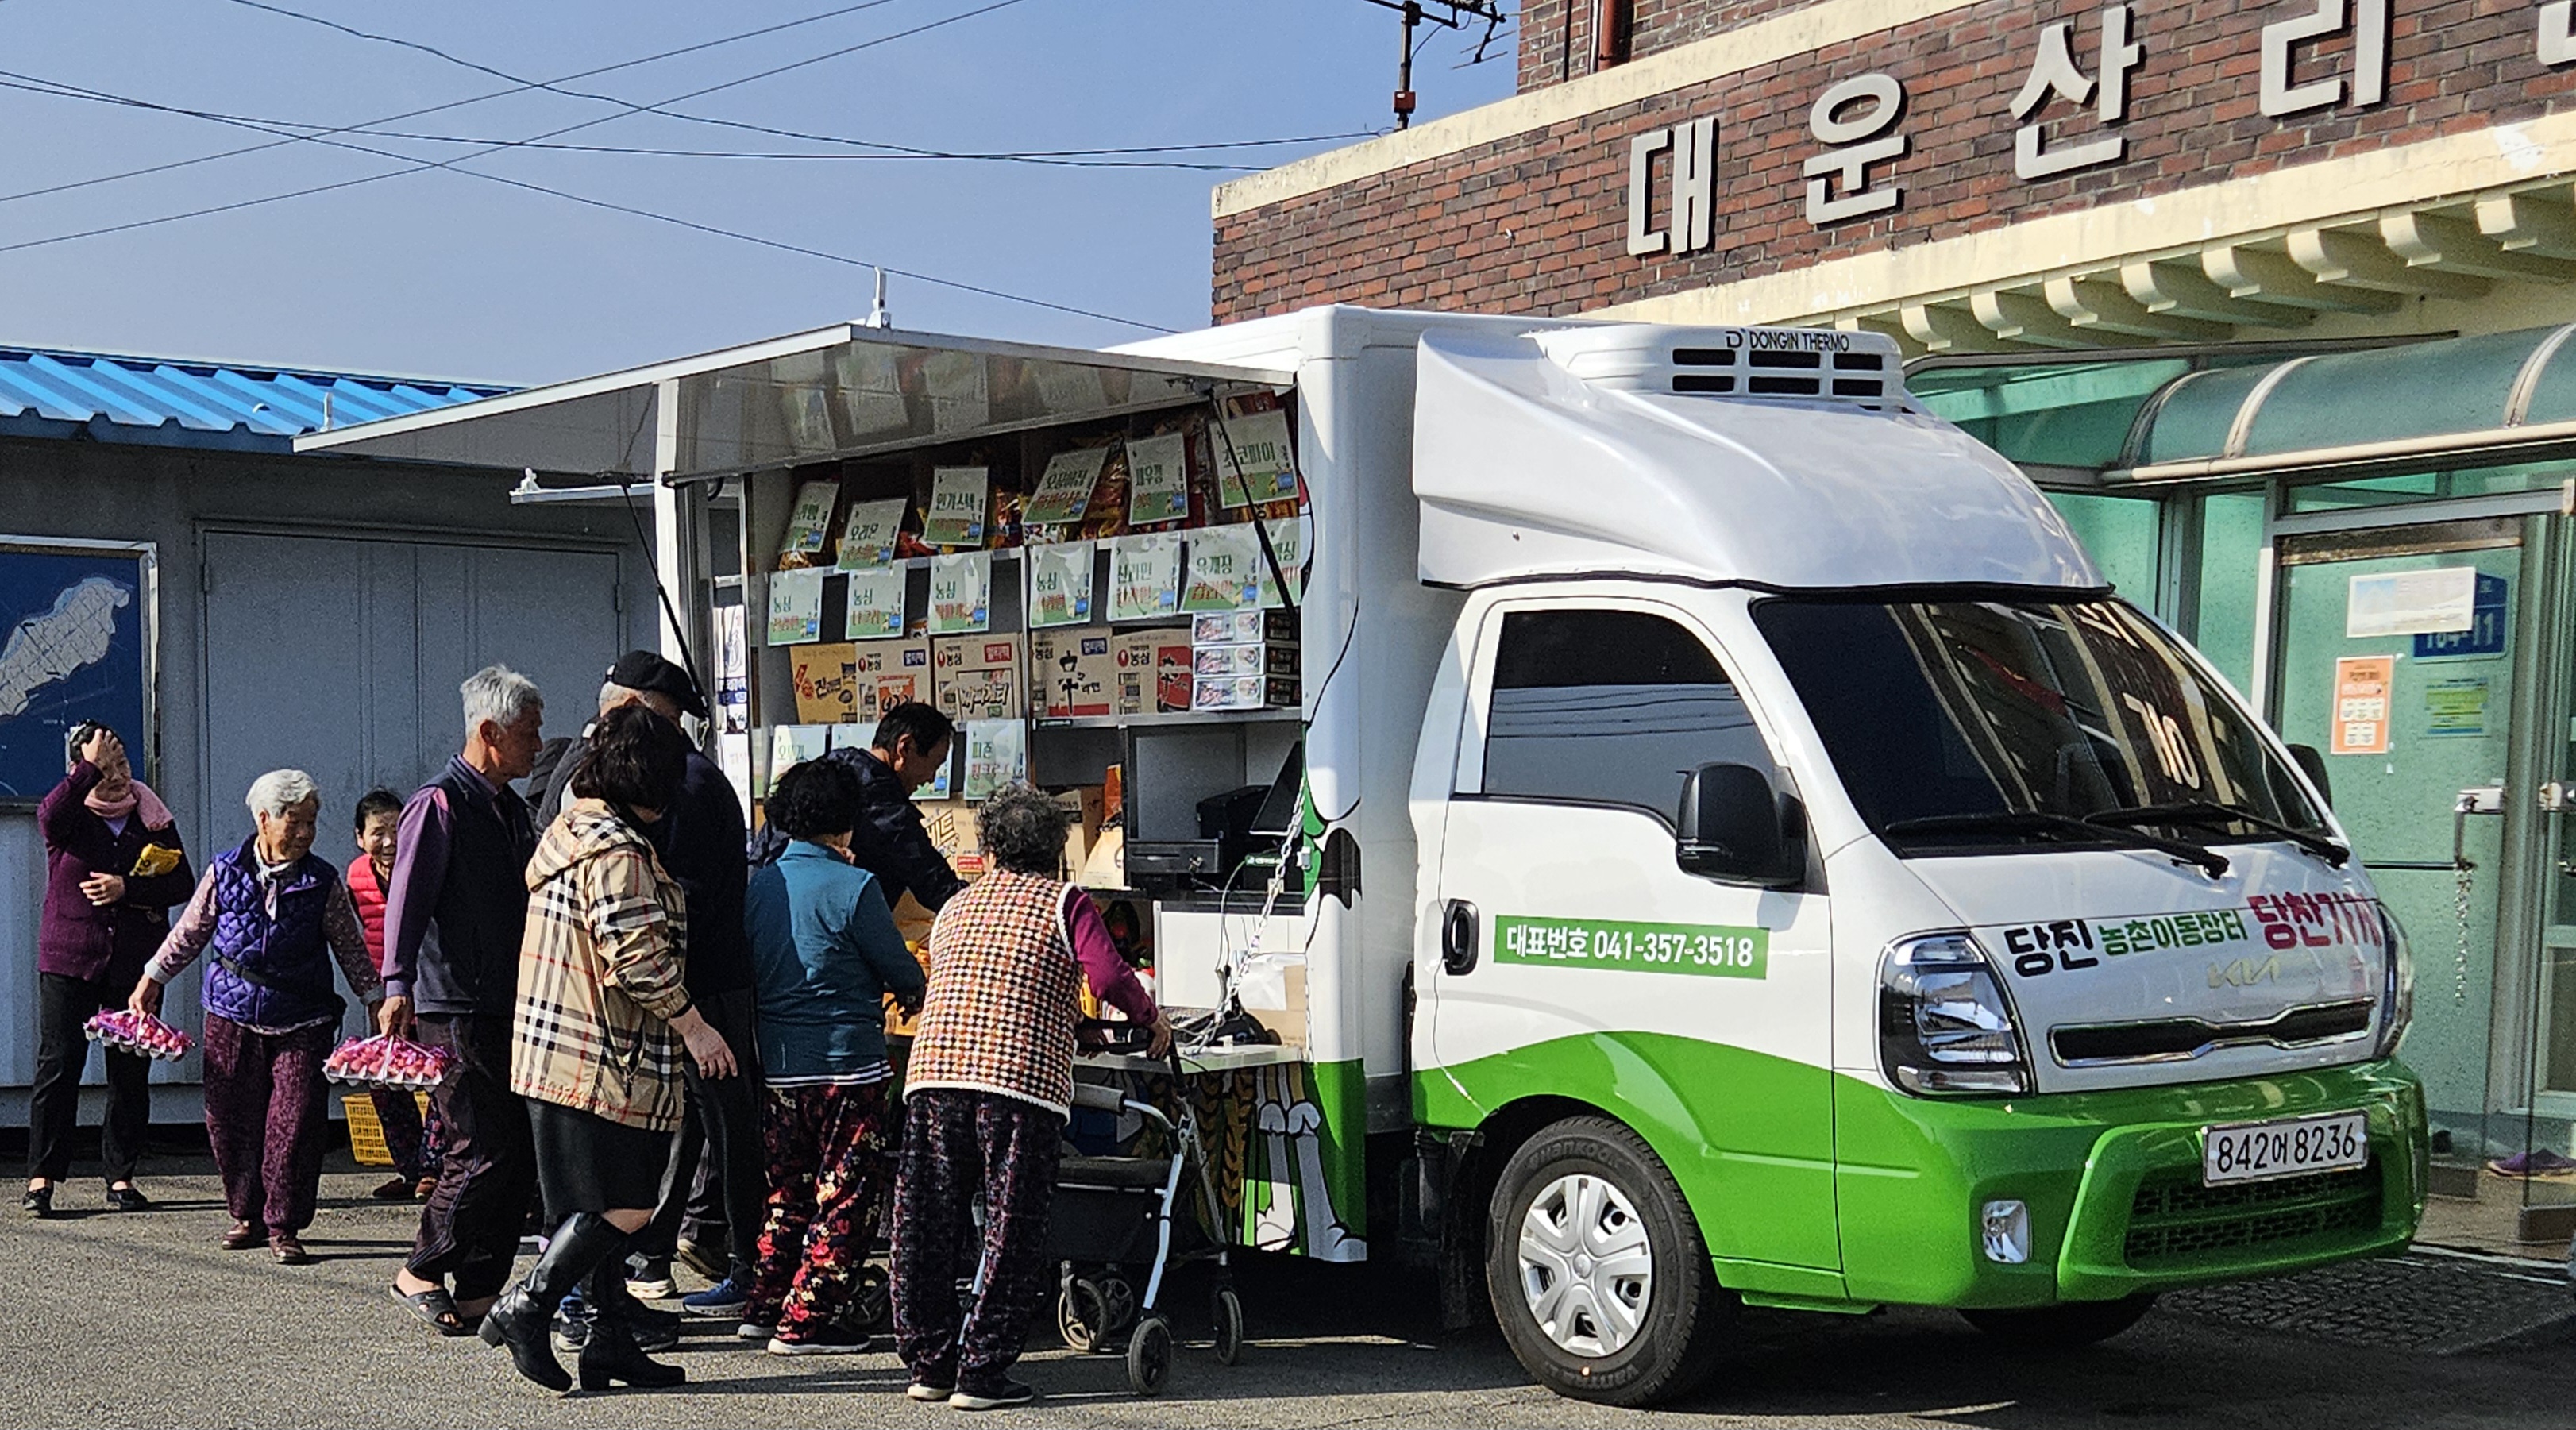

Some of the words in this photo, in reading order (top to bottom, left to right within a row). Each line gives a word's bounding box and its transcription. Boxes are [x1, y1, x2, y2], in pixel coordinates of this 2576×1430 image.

[1749, 330, 1799, 350] DONGIN
[1803, 333, 1849, 352] THERMO
[935, 580, 956, 600] 농심
[1036, 571, 1058, 592] 농심
[773, 595, 792, 614] 농심
[853, 587, 873, 607] 농심
[946, 653, 962, 667] 농심
[1035, 647, 1054, 660] 농심
[1130, 651, 1150, 667] 농심
[866, 658, 882, 672] 농심
[1506, 924, 1588, 958] 대표번호
[1593, 930, 1753, 967] 041-357-3518
[2004, 919, 2099, 977] 당진
[2098, 909, 2249, 956] 농촌이동장터
